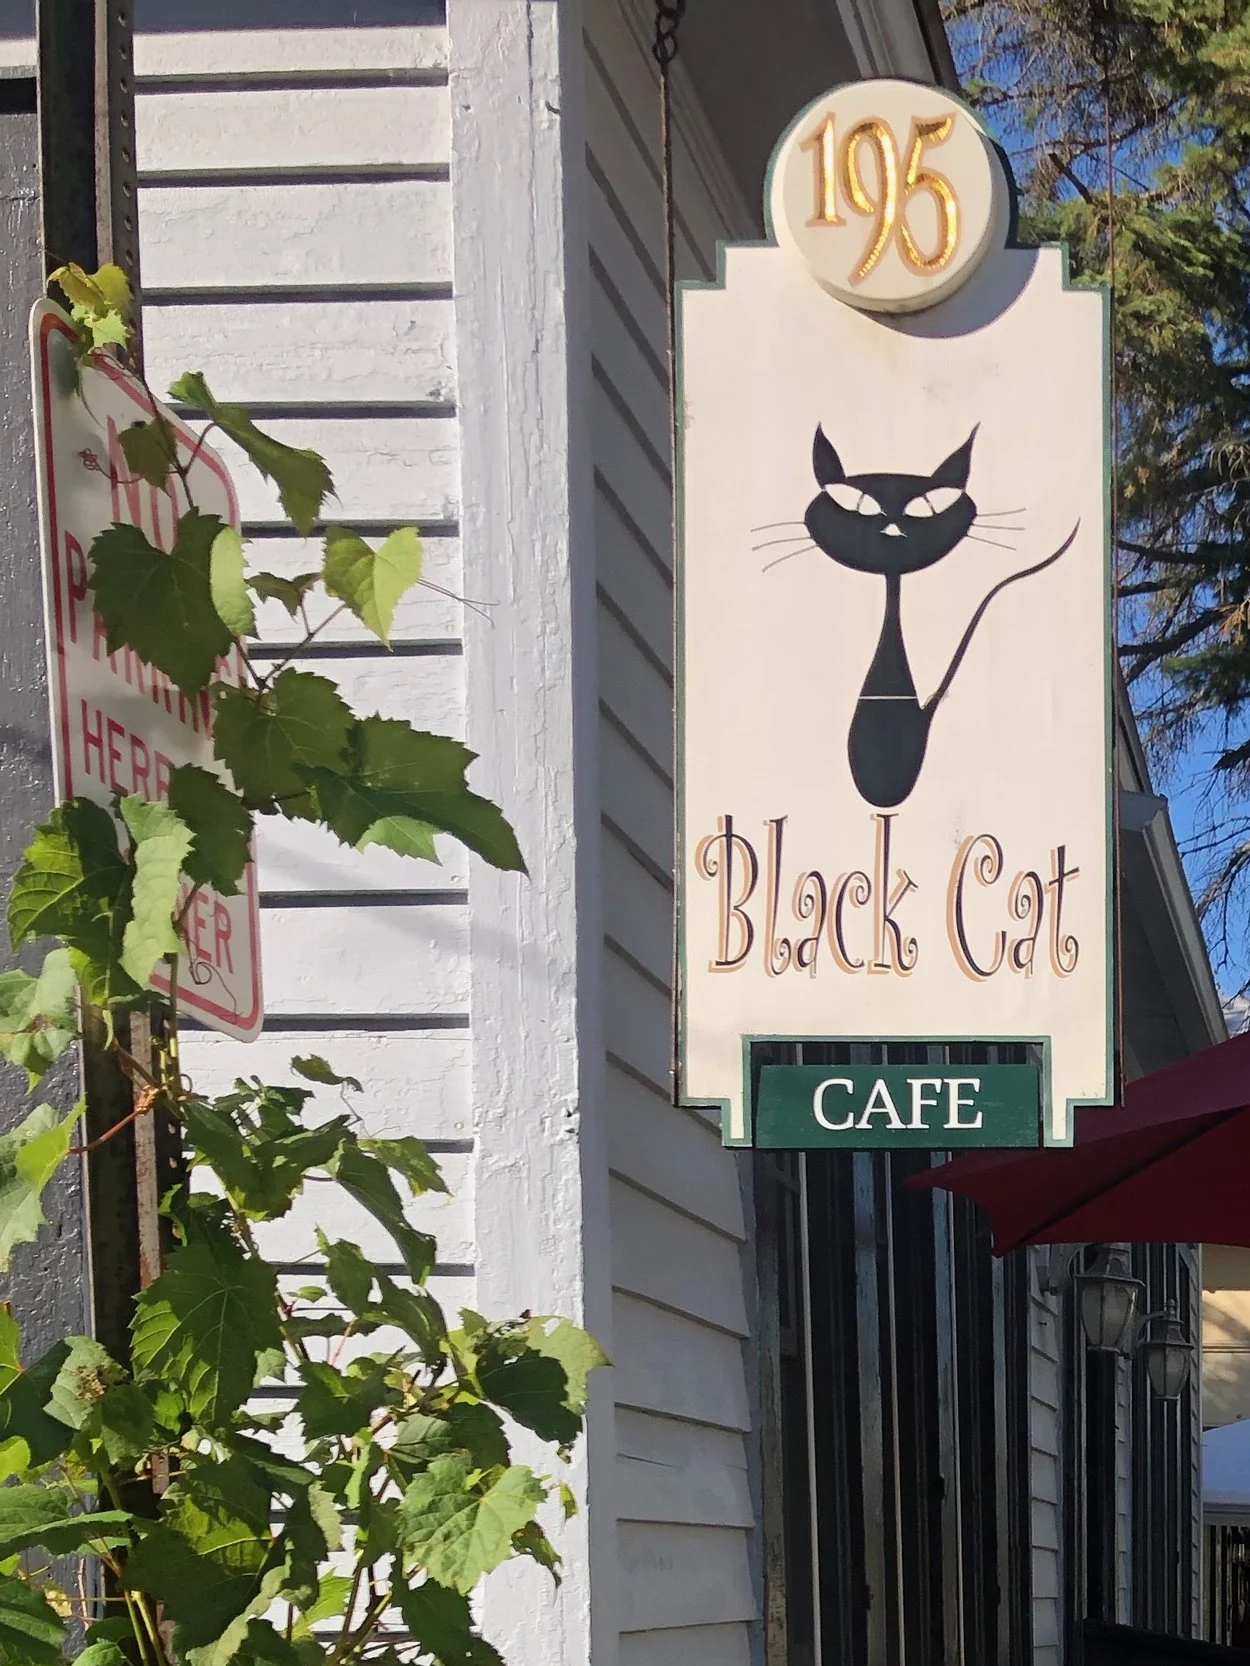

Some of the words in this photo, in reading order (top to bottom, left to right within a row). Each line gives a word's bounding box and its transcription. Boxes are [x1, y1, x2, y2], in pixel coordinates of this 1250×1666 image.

[799, 112, 961, 287] 195
[695, 813, 919, 979] Black
[946, 833, 1080, 982] Cat
[812, 1077, 983, 1130] CAFE
